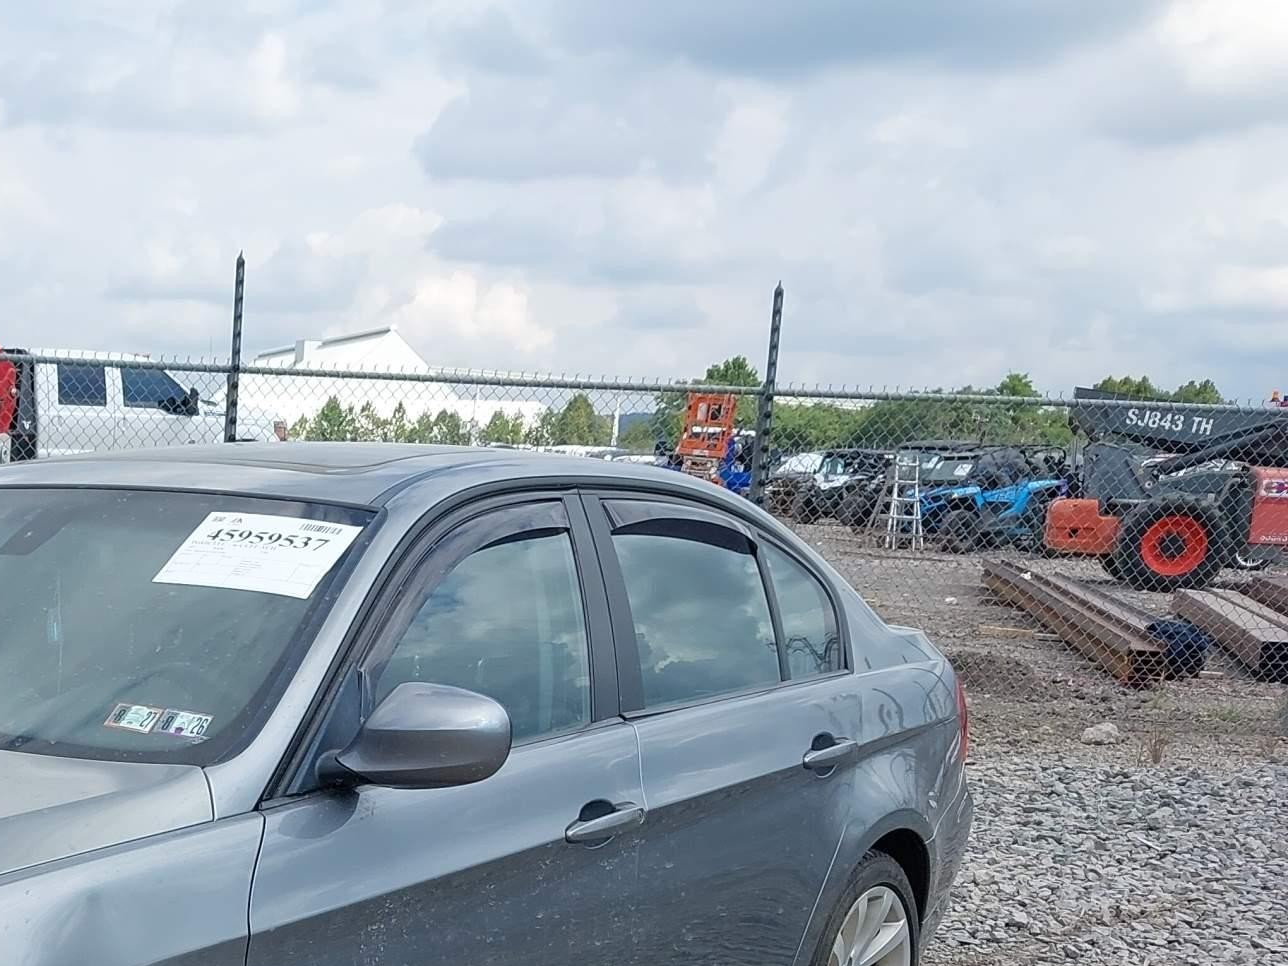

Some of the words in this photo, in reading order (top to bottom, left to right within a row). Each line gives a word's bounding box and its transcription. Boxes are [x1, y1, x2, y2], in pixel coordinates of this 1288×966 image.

[1125, 407, 1185, 431] SJ843
[1191, 416, 1214, 435] TH
[207, 528, 330, 551] 45959537
[138, 711, 158, 731] 27
[189, 717, 209, 735] 26
